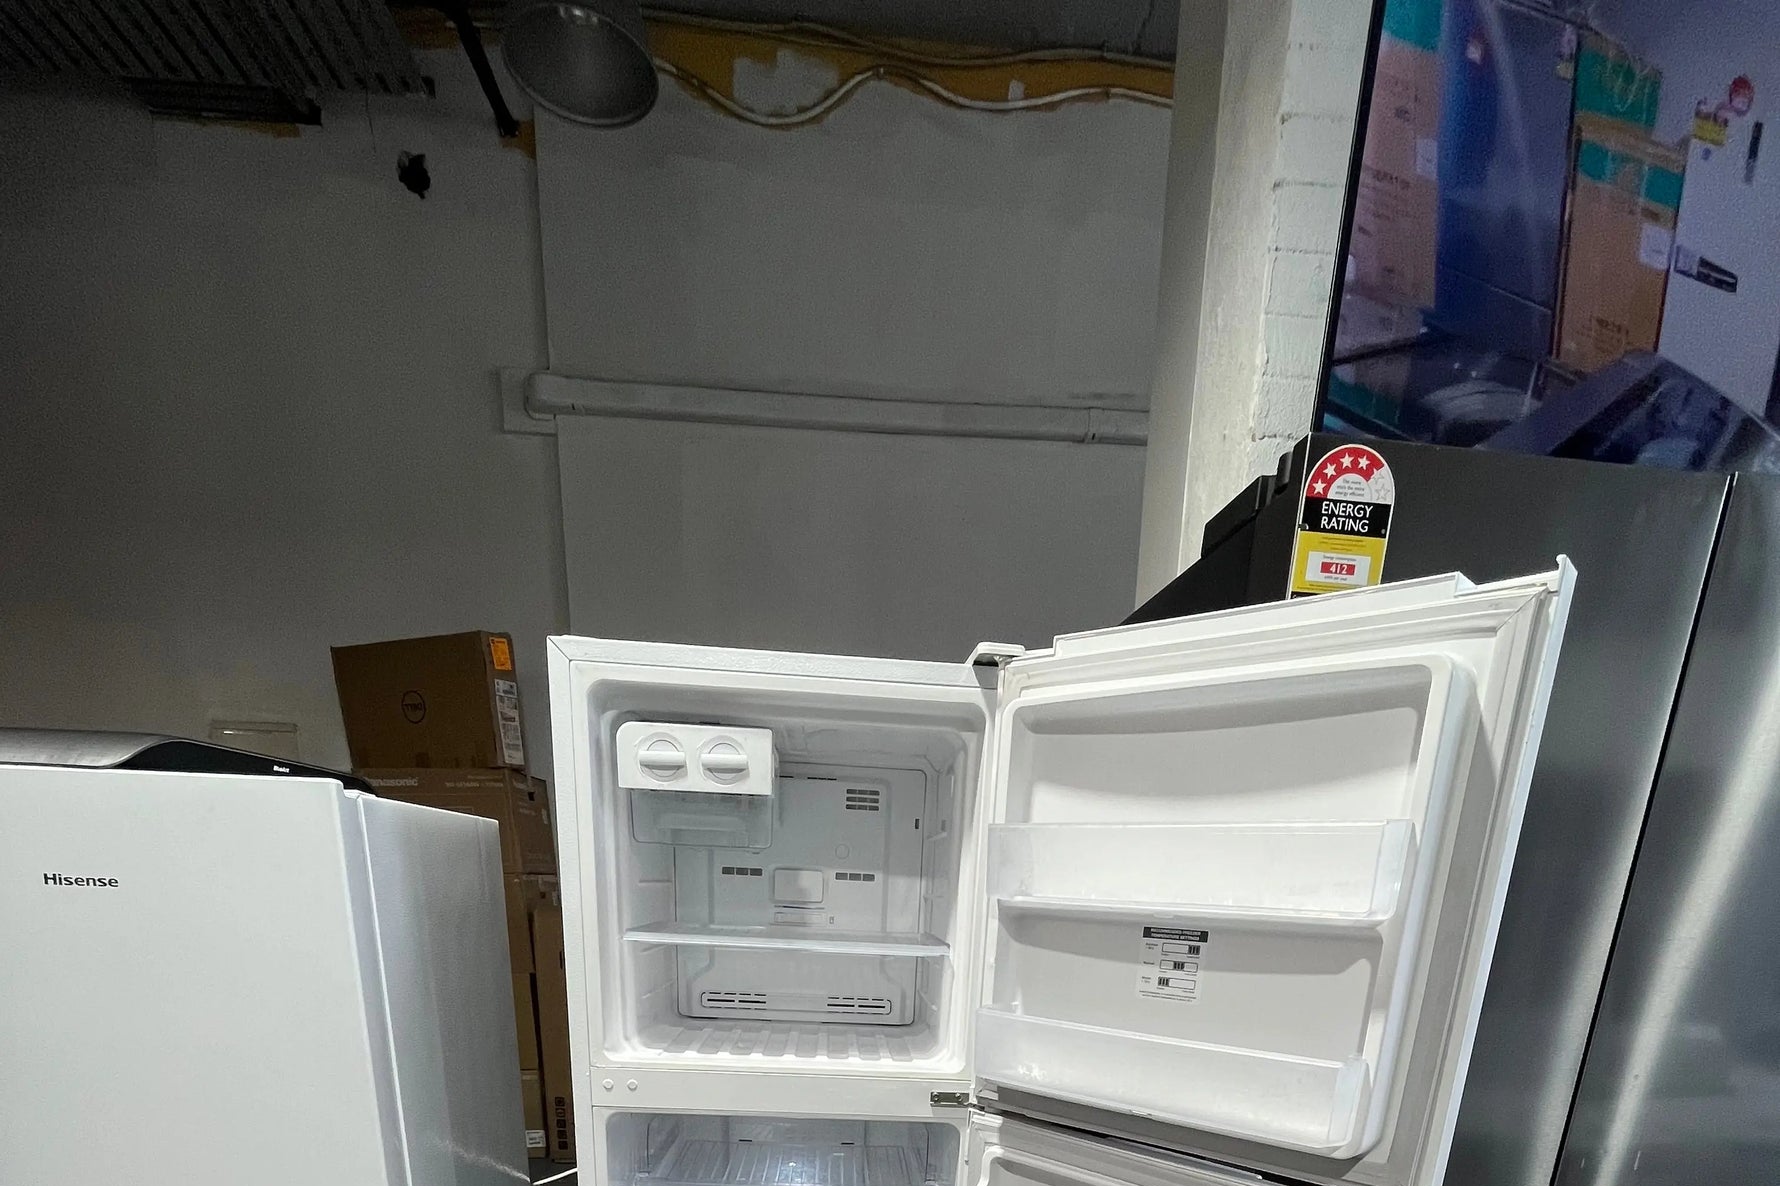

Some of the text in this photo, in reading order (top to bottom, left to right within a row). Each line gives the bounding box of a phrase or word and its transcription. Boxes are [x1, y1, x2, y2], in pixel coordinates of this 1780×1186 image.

[1321, 501, 1374, 518] ENERGY
[1320, 516, 1369, 533] RATING
[1329, 563, 1348, 574] 412
[43, 873, 119, 888] Hisense
